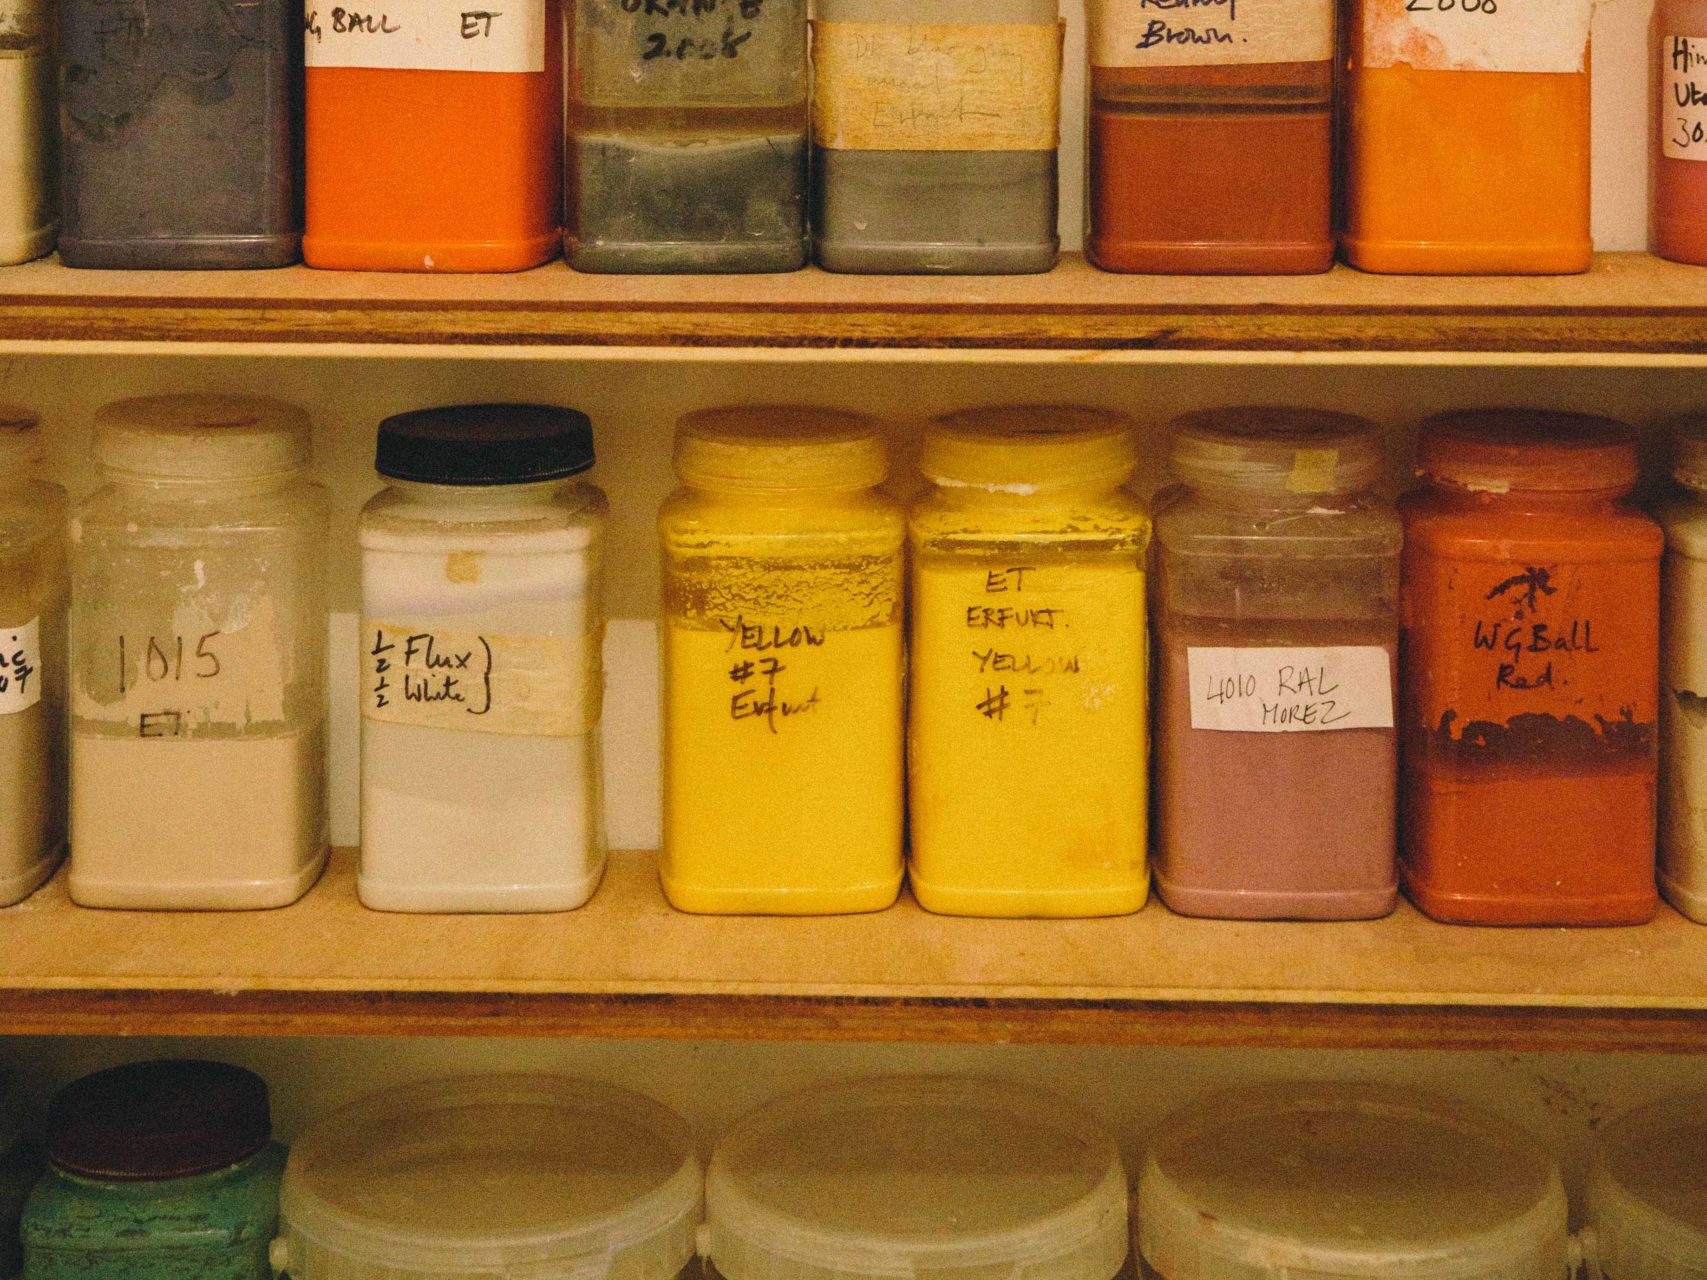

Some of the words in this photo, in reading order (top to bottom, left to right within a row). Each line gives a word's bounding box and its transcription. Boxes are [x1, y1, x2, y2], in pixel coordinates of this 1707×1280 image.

[331, 6, 401, 34] BALL
[460, 10, 503, 39] ET
[985, 566, 1037, 593] ET
[719, 614, 827, 653] YELLOW
[404, 632, 472, 672] Flux
[972, 648, 1082, 675] YELLOW
[404, 674, 465, 704] White
[1206, 673, 1257, 706] 4010
[1278, 665, 1340, 697] RAL
[1262, 699, 1352, 727] MOREZ
